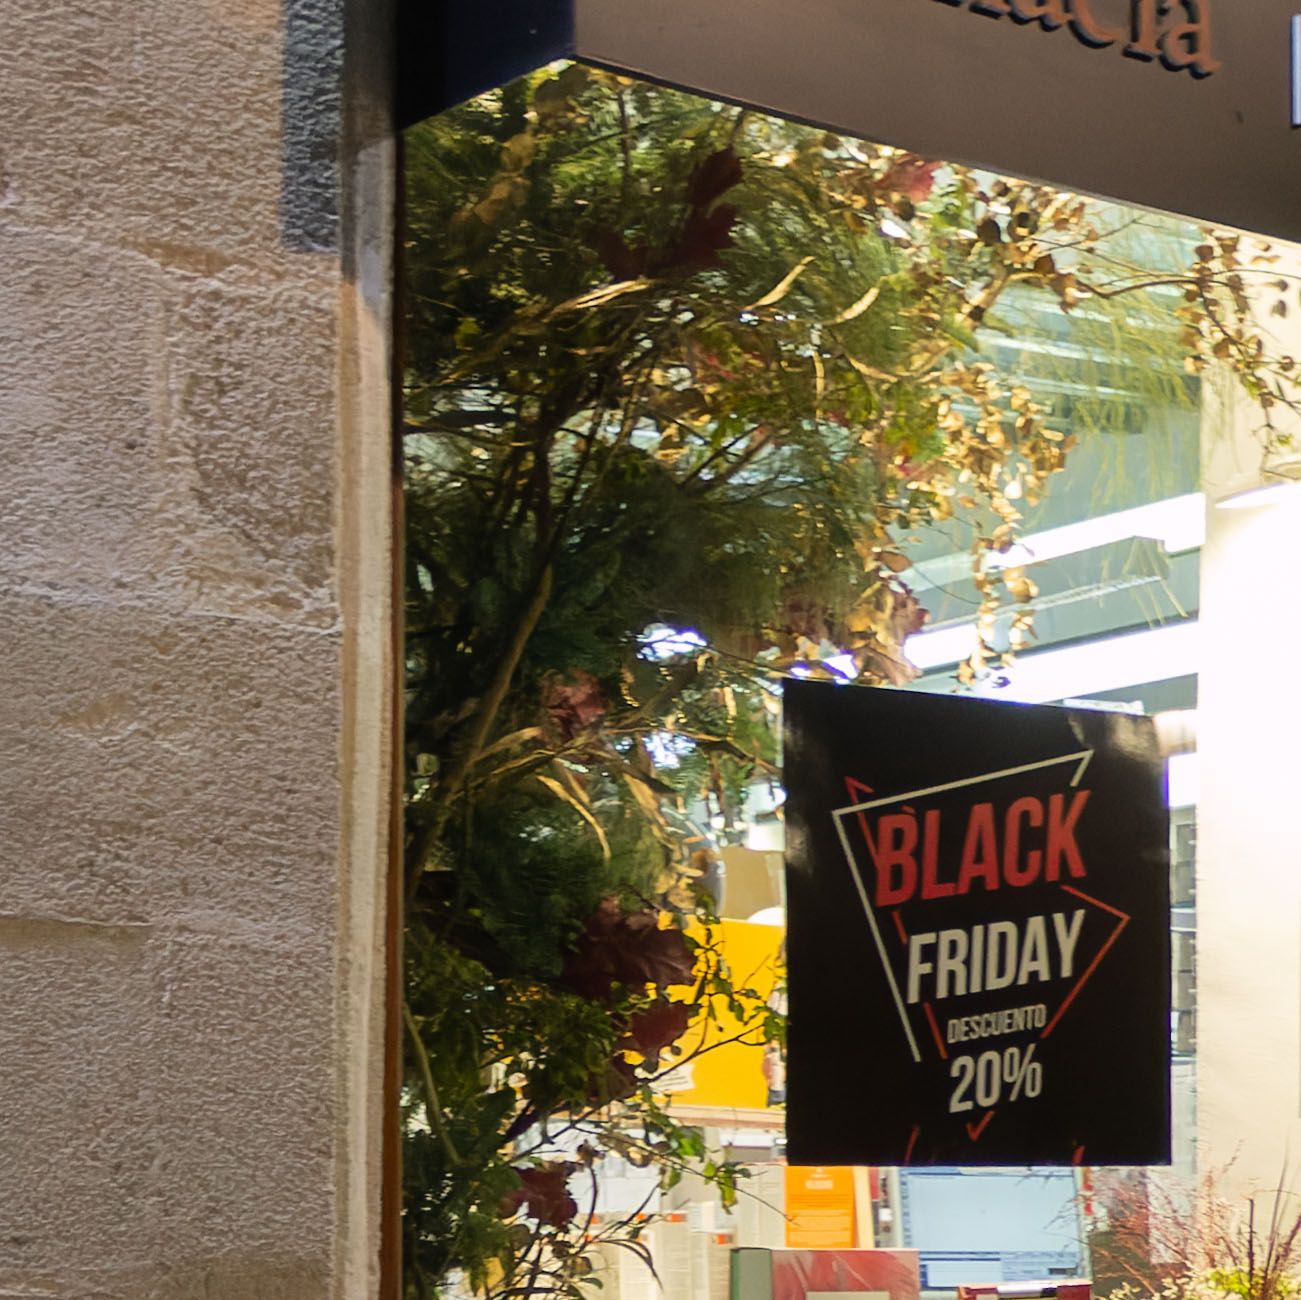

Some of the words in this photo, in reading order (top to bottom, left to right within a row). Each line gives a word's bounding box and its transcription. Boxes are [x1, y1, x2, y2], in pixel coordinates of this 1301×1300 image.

[875, 789, 1092, 908] BLACK
[906, 908, 1087, 1005] FRIDAY
[946, 1003, 1048, 1044] DESCUENTO
[948, 1042, 1043, 1114] 20%
